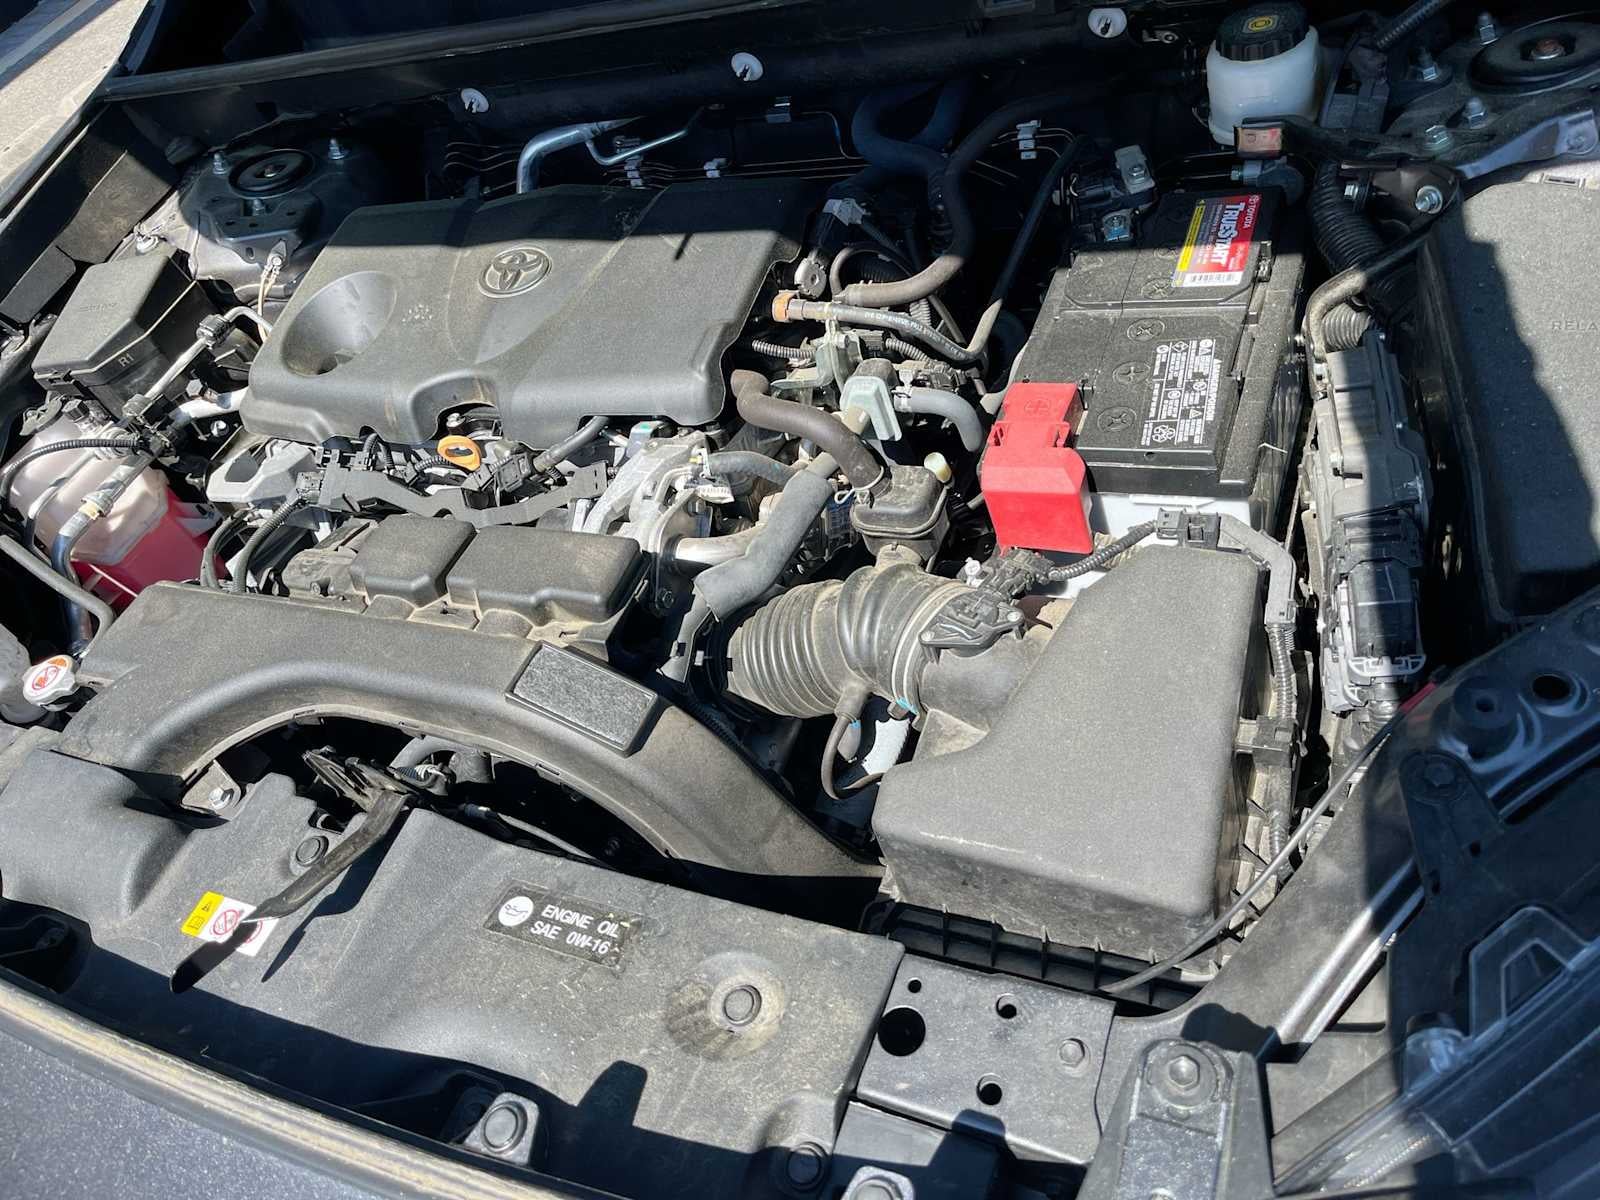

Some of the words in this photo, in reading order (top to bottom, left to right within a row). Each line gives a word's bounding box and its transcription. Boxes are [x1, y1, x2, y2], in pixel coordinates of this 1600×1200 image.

[1243, 204, 1257, 229] TOYOTA
[530, 920, 562, 940] SAE
[565, 931, 611, 954] 0W-16
[541, 904, 594, 929] ENGINE
[597, 920, 619, 938] OIL
